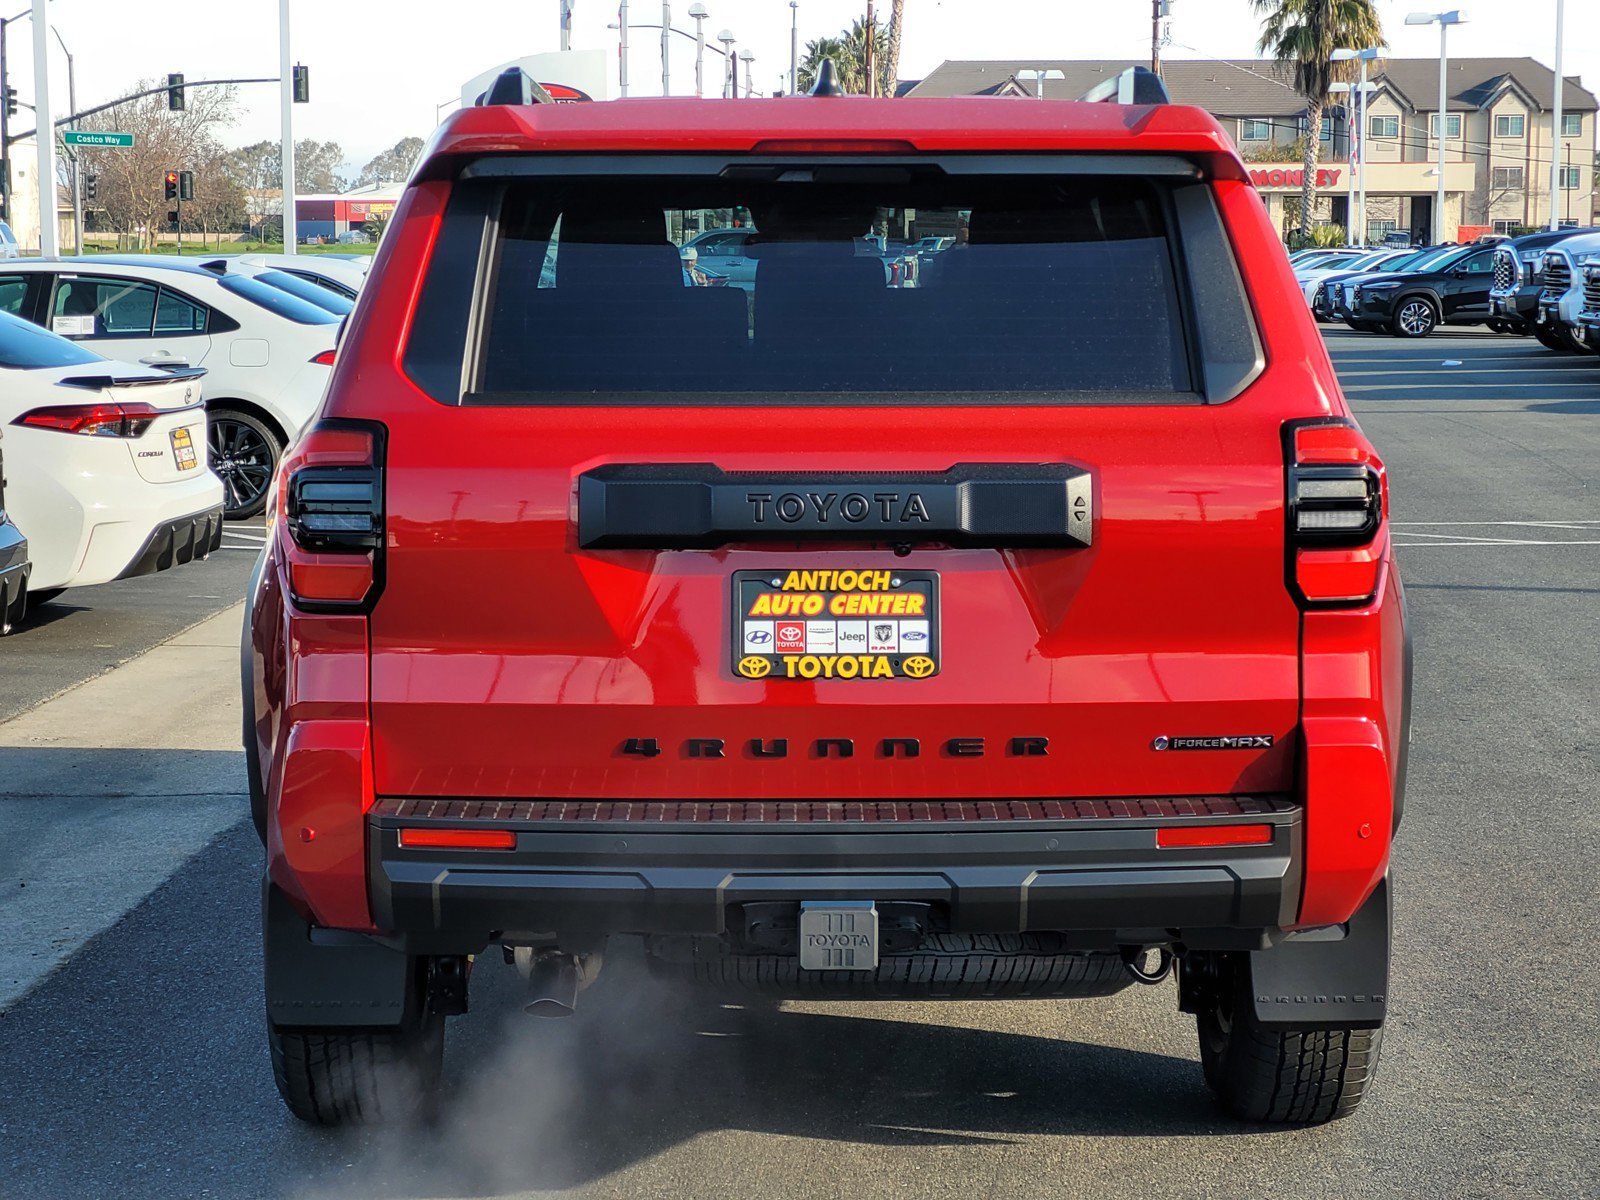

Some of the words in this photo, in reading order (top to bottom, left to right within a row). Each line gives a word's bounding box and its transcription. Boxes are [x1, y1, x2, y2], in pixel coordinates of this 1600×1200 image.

[76, 135, 103, 143] Costco
[105, 136, 120, 145] Way
[1250, 169, 1341, 187] MONEY
[746, 493, 930, 523] TOYOTA
[782, 570, 891, 591] ANTIOCH
[749, 593, 825, 616] AUTO
[829, 593, 926, 616] CENTER
[839, 632, 866, 642] Jeep
[783, 656, 894, 678] TOYOTA
[623, 737, 1050, 758] 4RUNNER
[805, 935, 870, 946] TOYOTA
